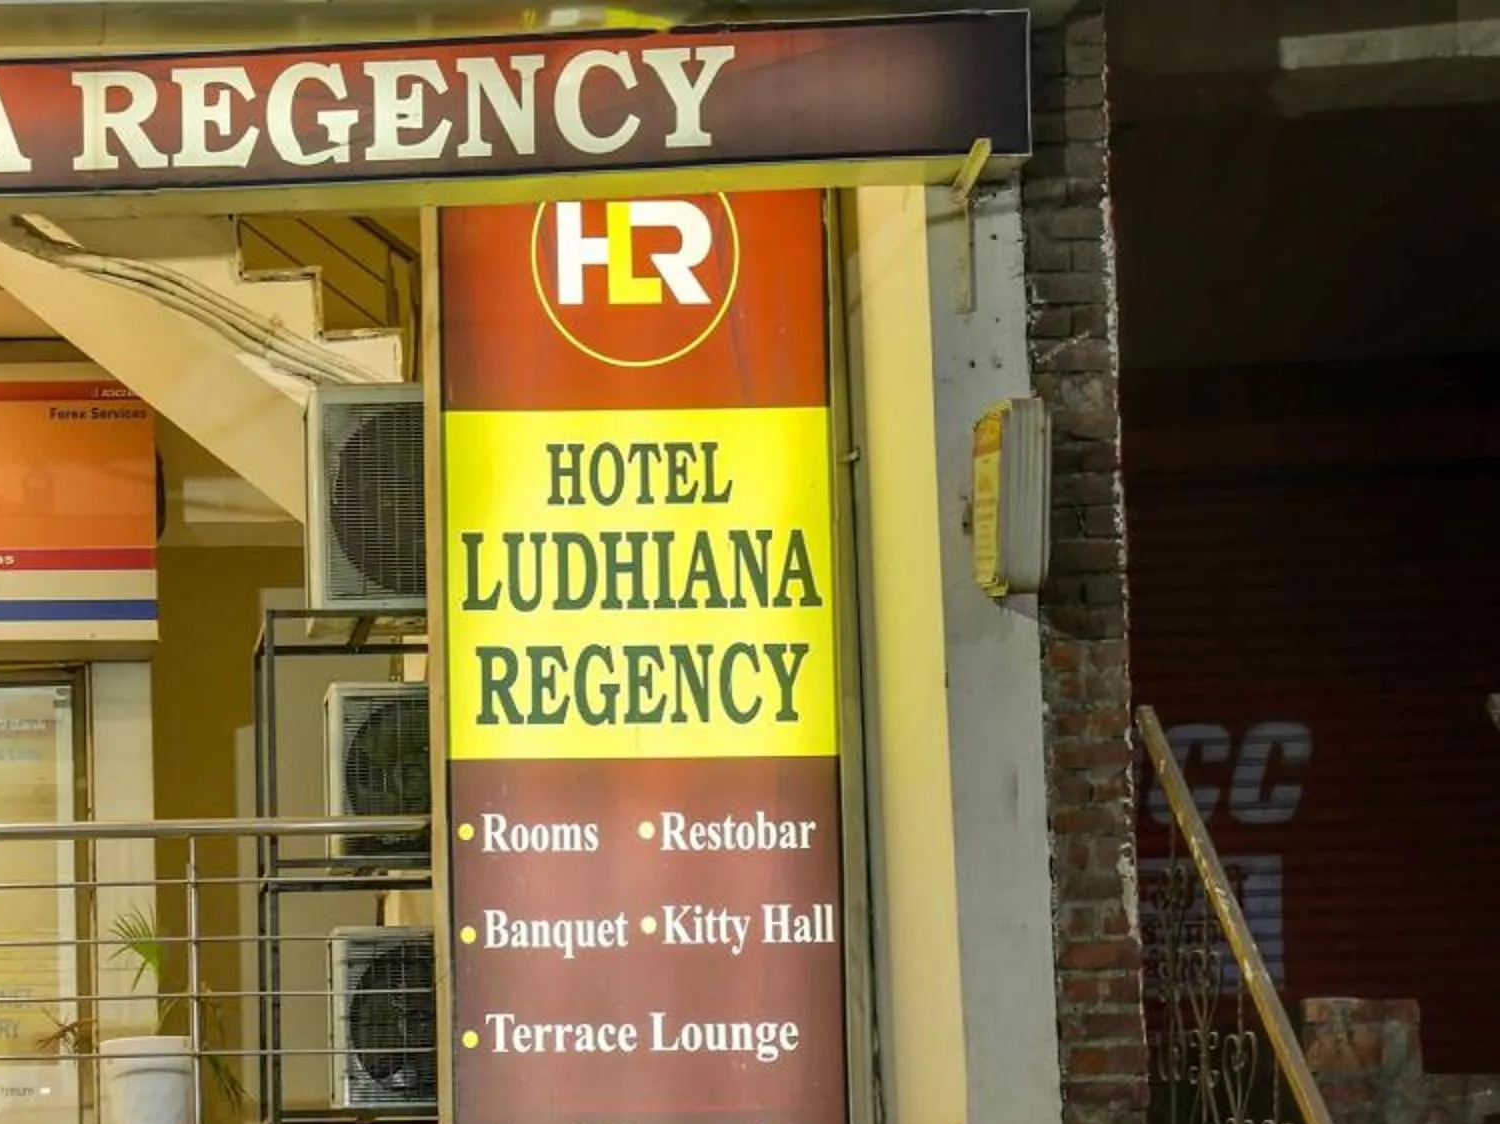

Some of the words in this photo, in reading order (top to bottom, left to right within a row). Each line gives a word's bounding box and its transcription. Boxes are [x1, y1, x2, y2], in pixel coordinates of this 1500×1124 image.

[72, 44, 736, 171] REGENCY
[49, 407, 87, 419] Forex
[91, 407, 148, 419] Services
[546, 441, 733, 507] HOTEL
[460, 529, 823, 612] LUDHIANA
[474, 641, 811, 727] REGENCY
[481, 813, 599, 853] Rooms
[659, 811, 816, 851] Restobar
[484, 909, 629, 959] Banquet
[661, 904, 752, 955] Kitty
[762, 903, 836, 945] Hall
[485, 1013, 638, 1053] Terrace
[649, 1012, 800, 1062] Lounge
